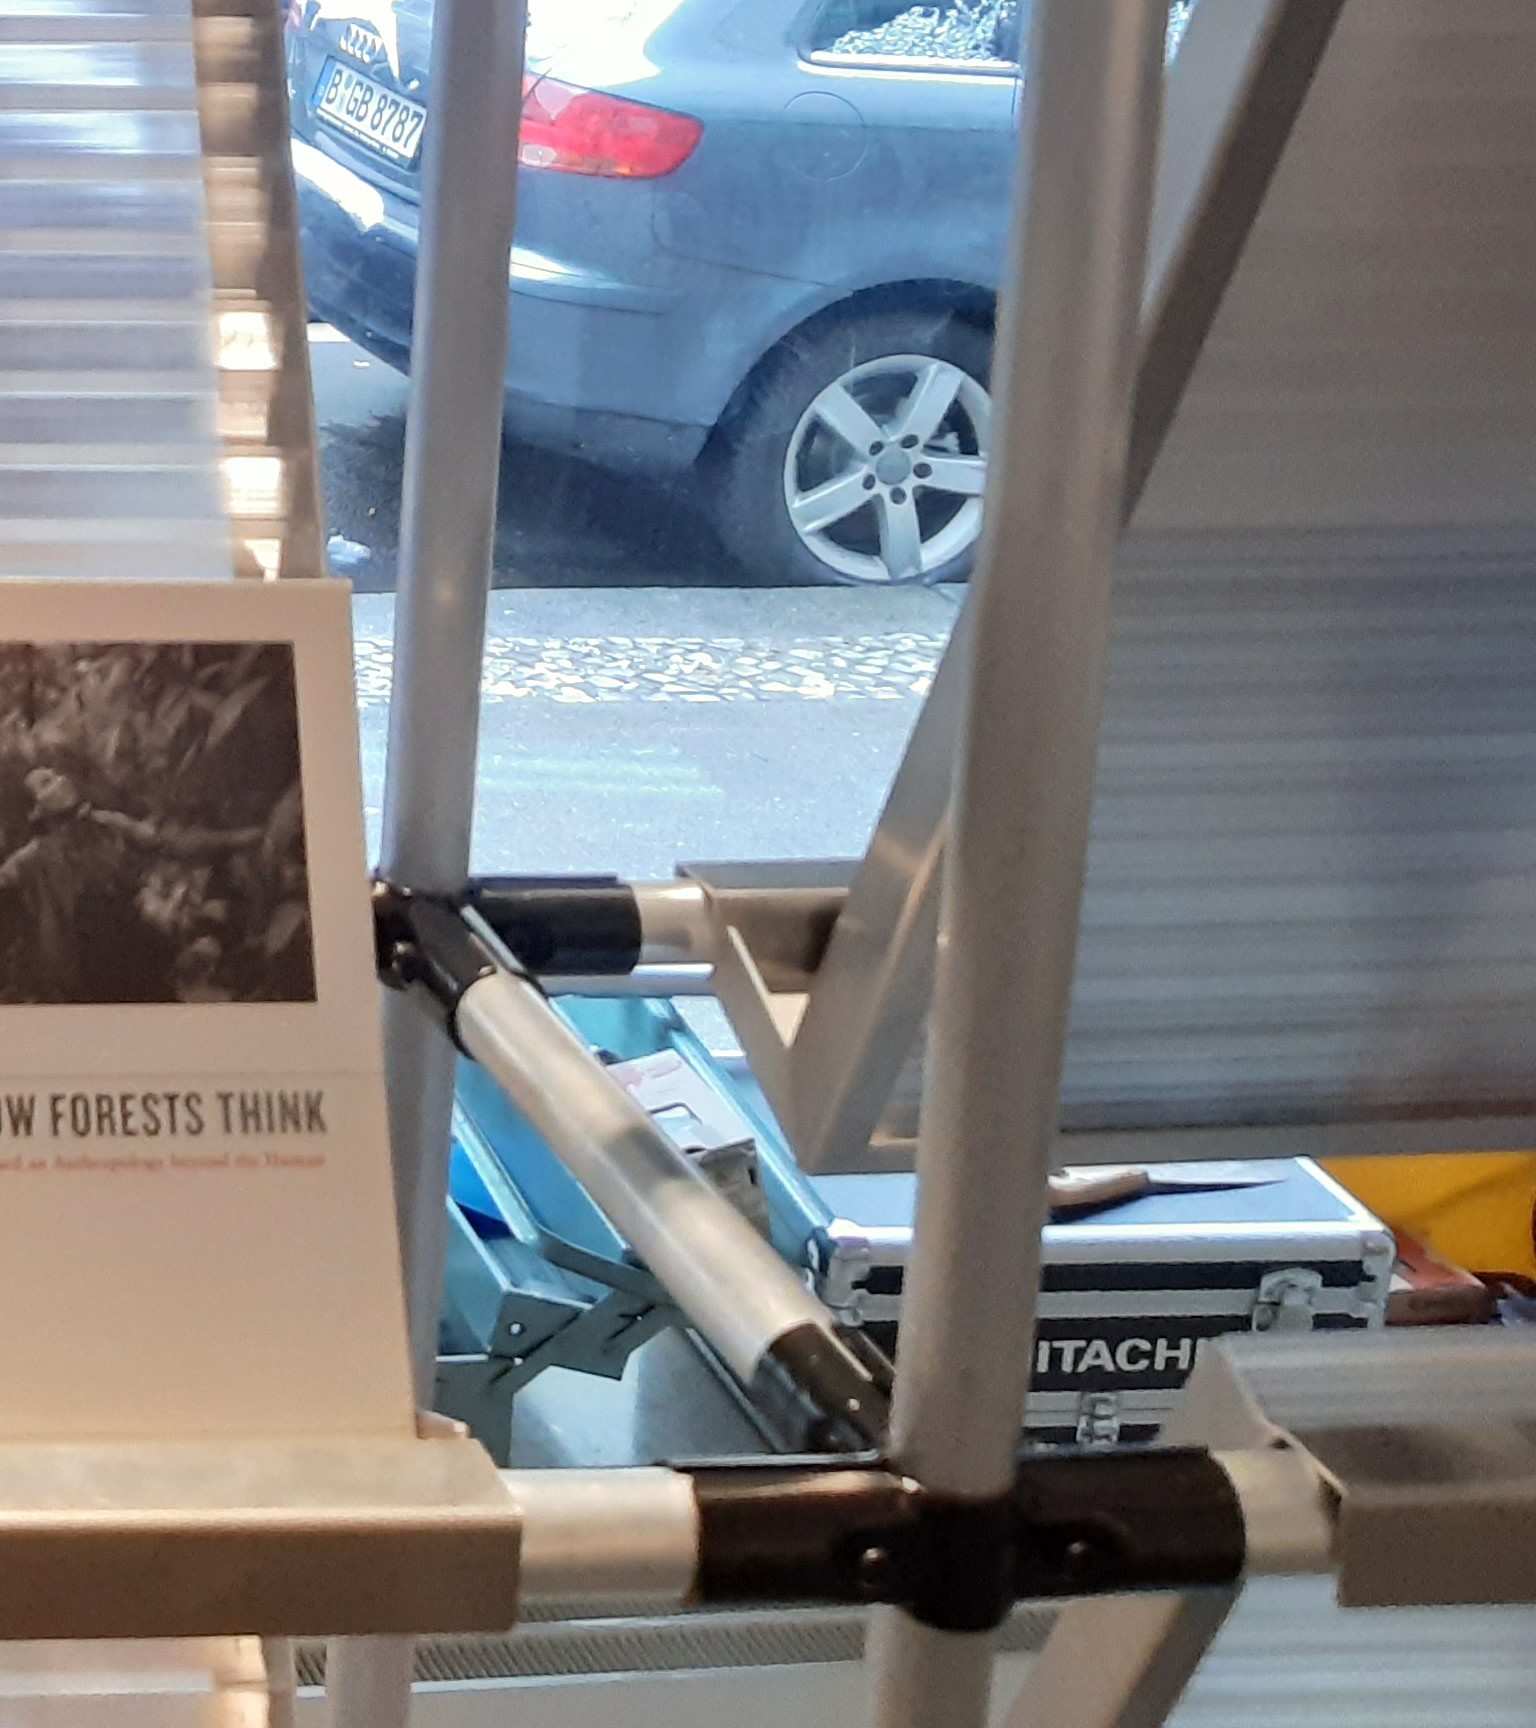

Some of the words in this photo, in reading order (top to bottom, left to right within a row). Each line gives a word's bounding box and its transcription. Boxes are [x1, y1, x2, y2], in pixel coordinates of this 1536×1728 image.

[325, 69, 343, 104] B
[345, 81, 374, 123] GB
[370, 93, 425, 149] 8787
[50, 1092, 204, 1138] FORESTS
[216, 1091, 327, 1135] THINK
